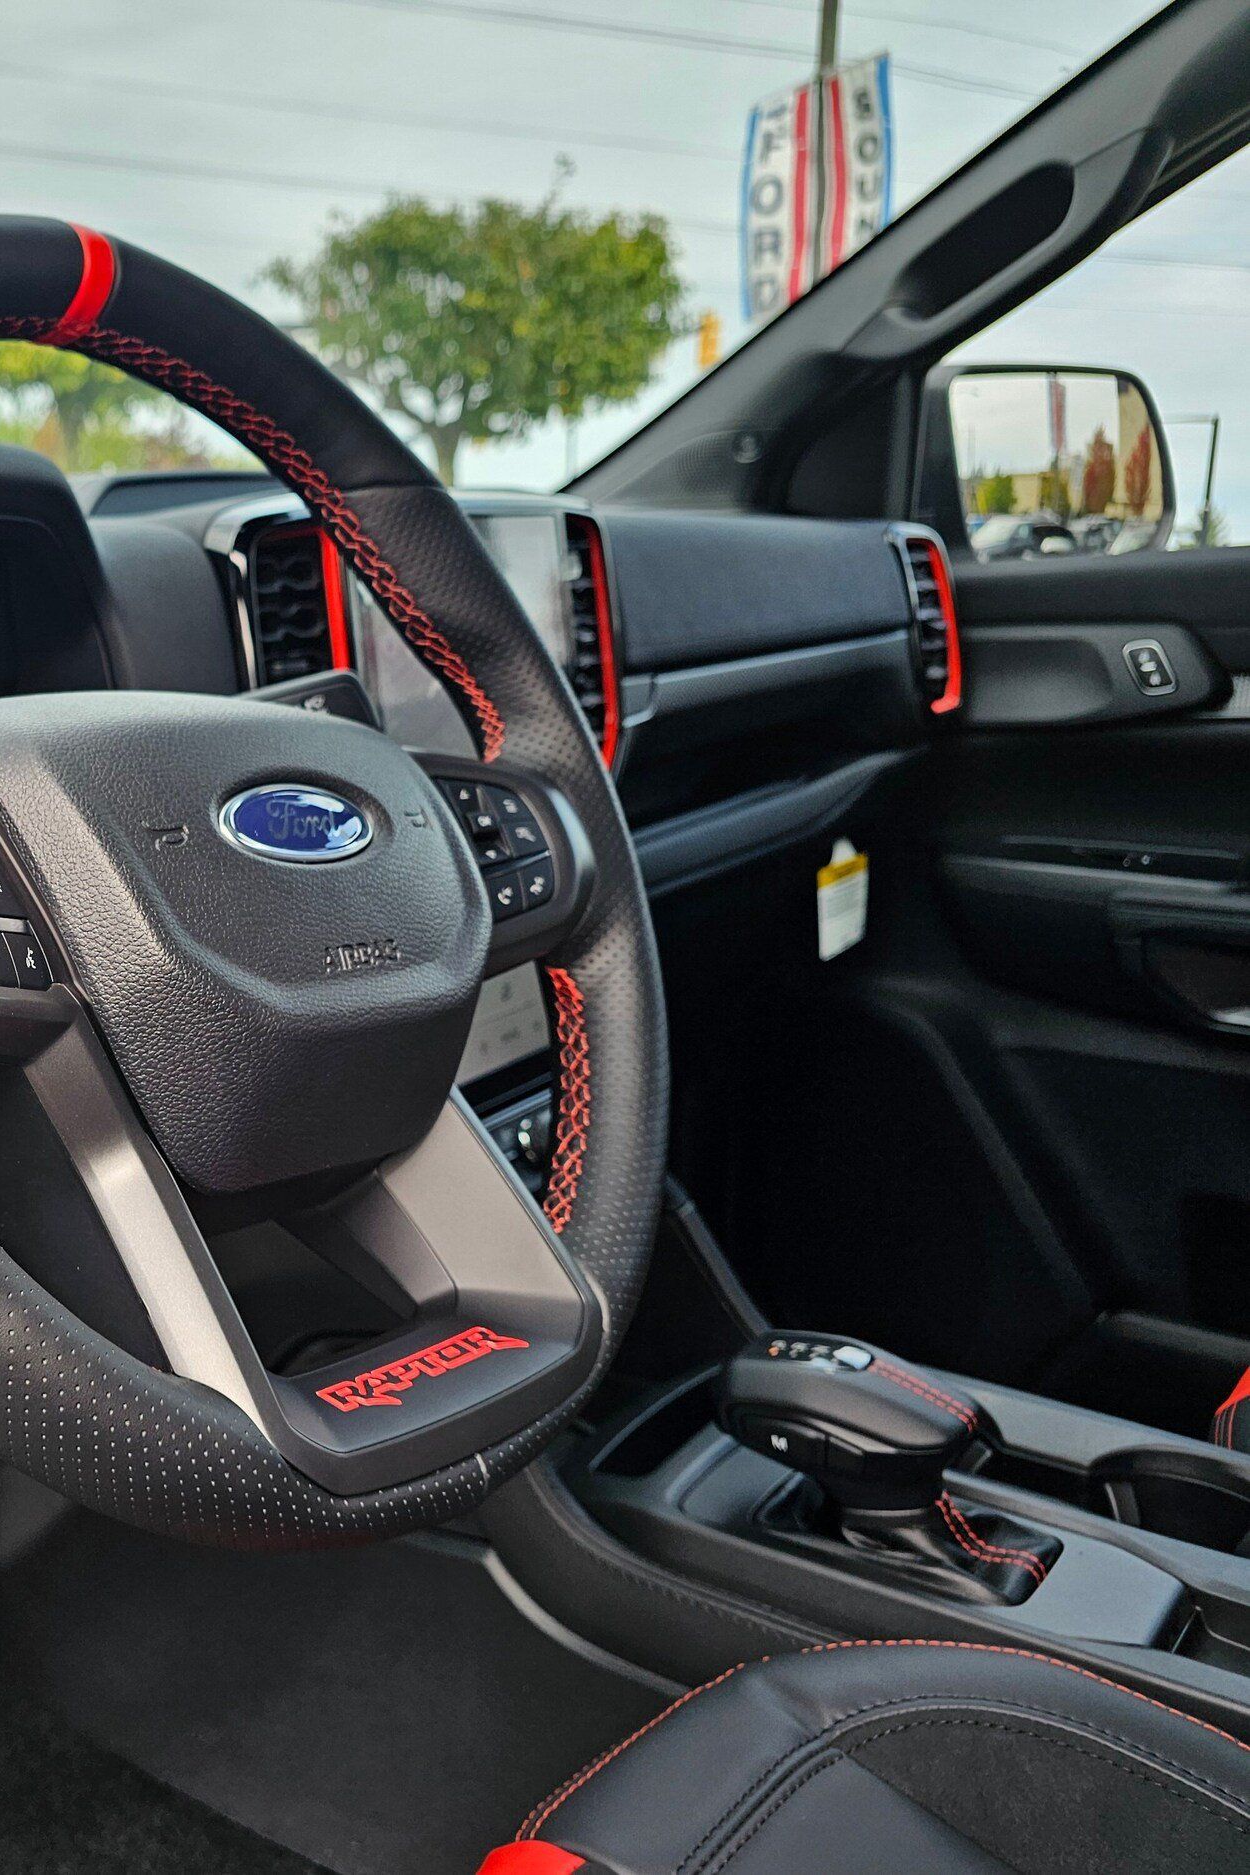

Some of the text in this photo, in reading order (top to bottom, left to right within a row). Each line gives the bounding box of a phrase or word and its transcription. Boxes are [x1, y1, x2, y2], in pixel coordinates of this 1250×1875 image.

[266, 799, 340, 841] Ford
[323, 938, 402, 973] AIRBAG
[316, 1325, 531, 1413] RAPTOR
